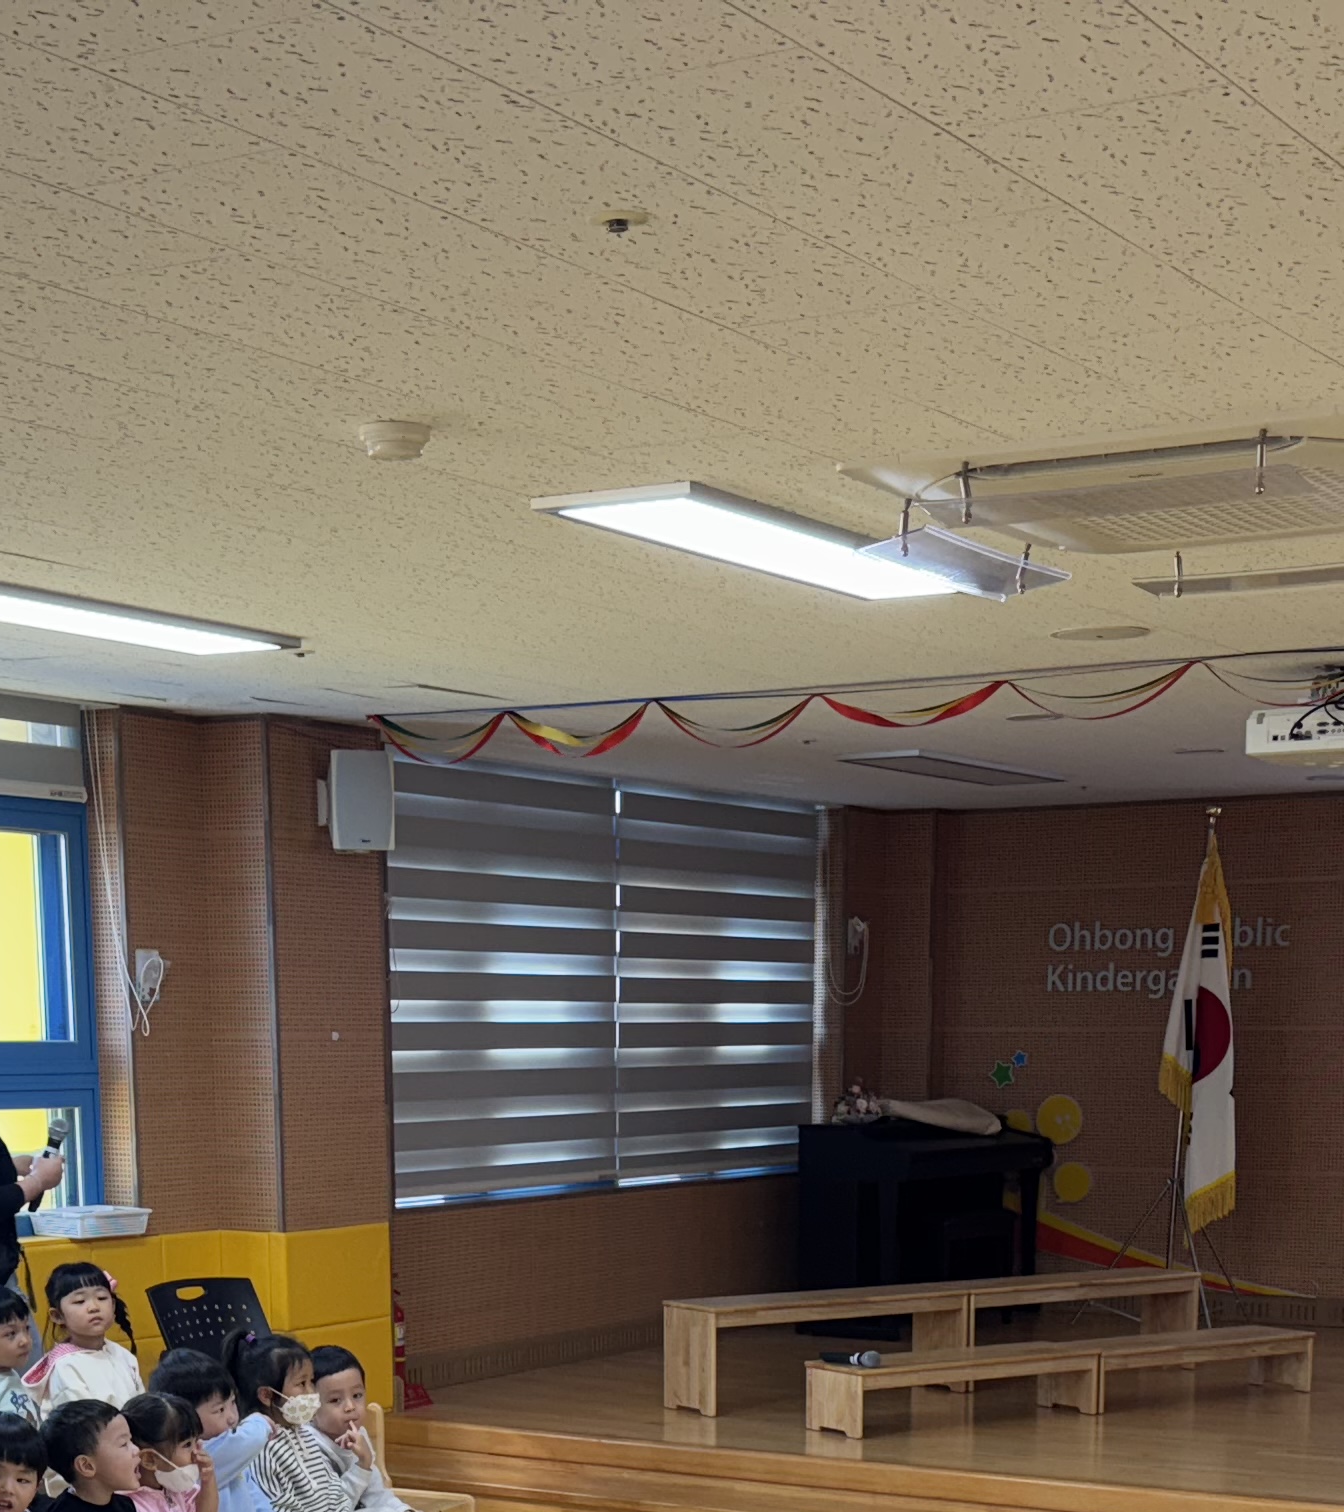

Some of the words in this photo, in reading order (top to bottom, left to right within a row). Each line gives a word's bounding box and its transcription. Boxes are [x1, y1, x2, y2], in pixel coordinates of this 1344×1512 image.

[1049, 920, 1175, 957] Ohbong
[1233, 917, 1291, 947] blic
[1046, 962, 1254, 998] Kindergan
